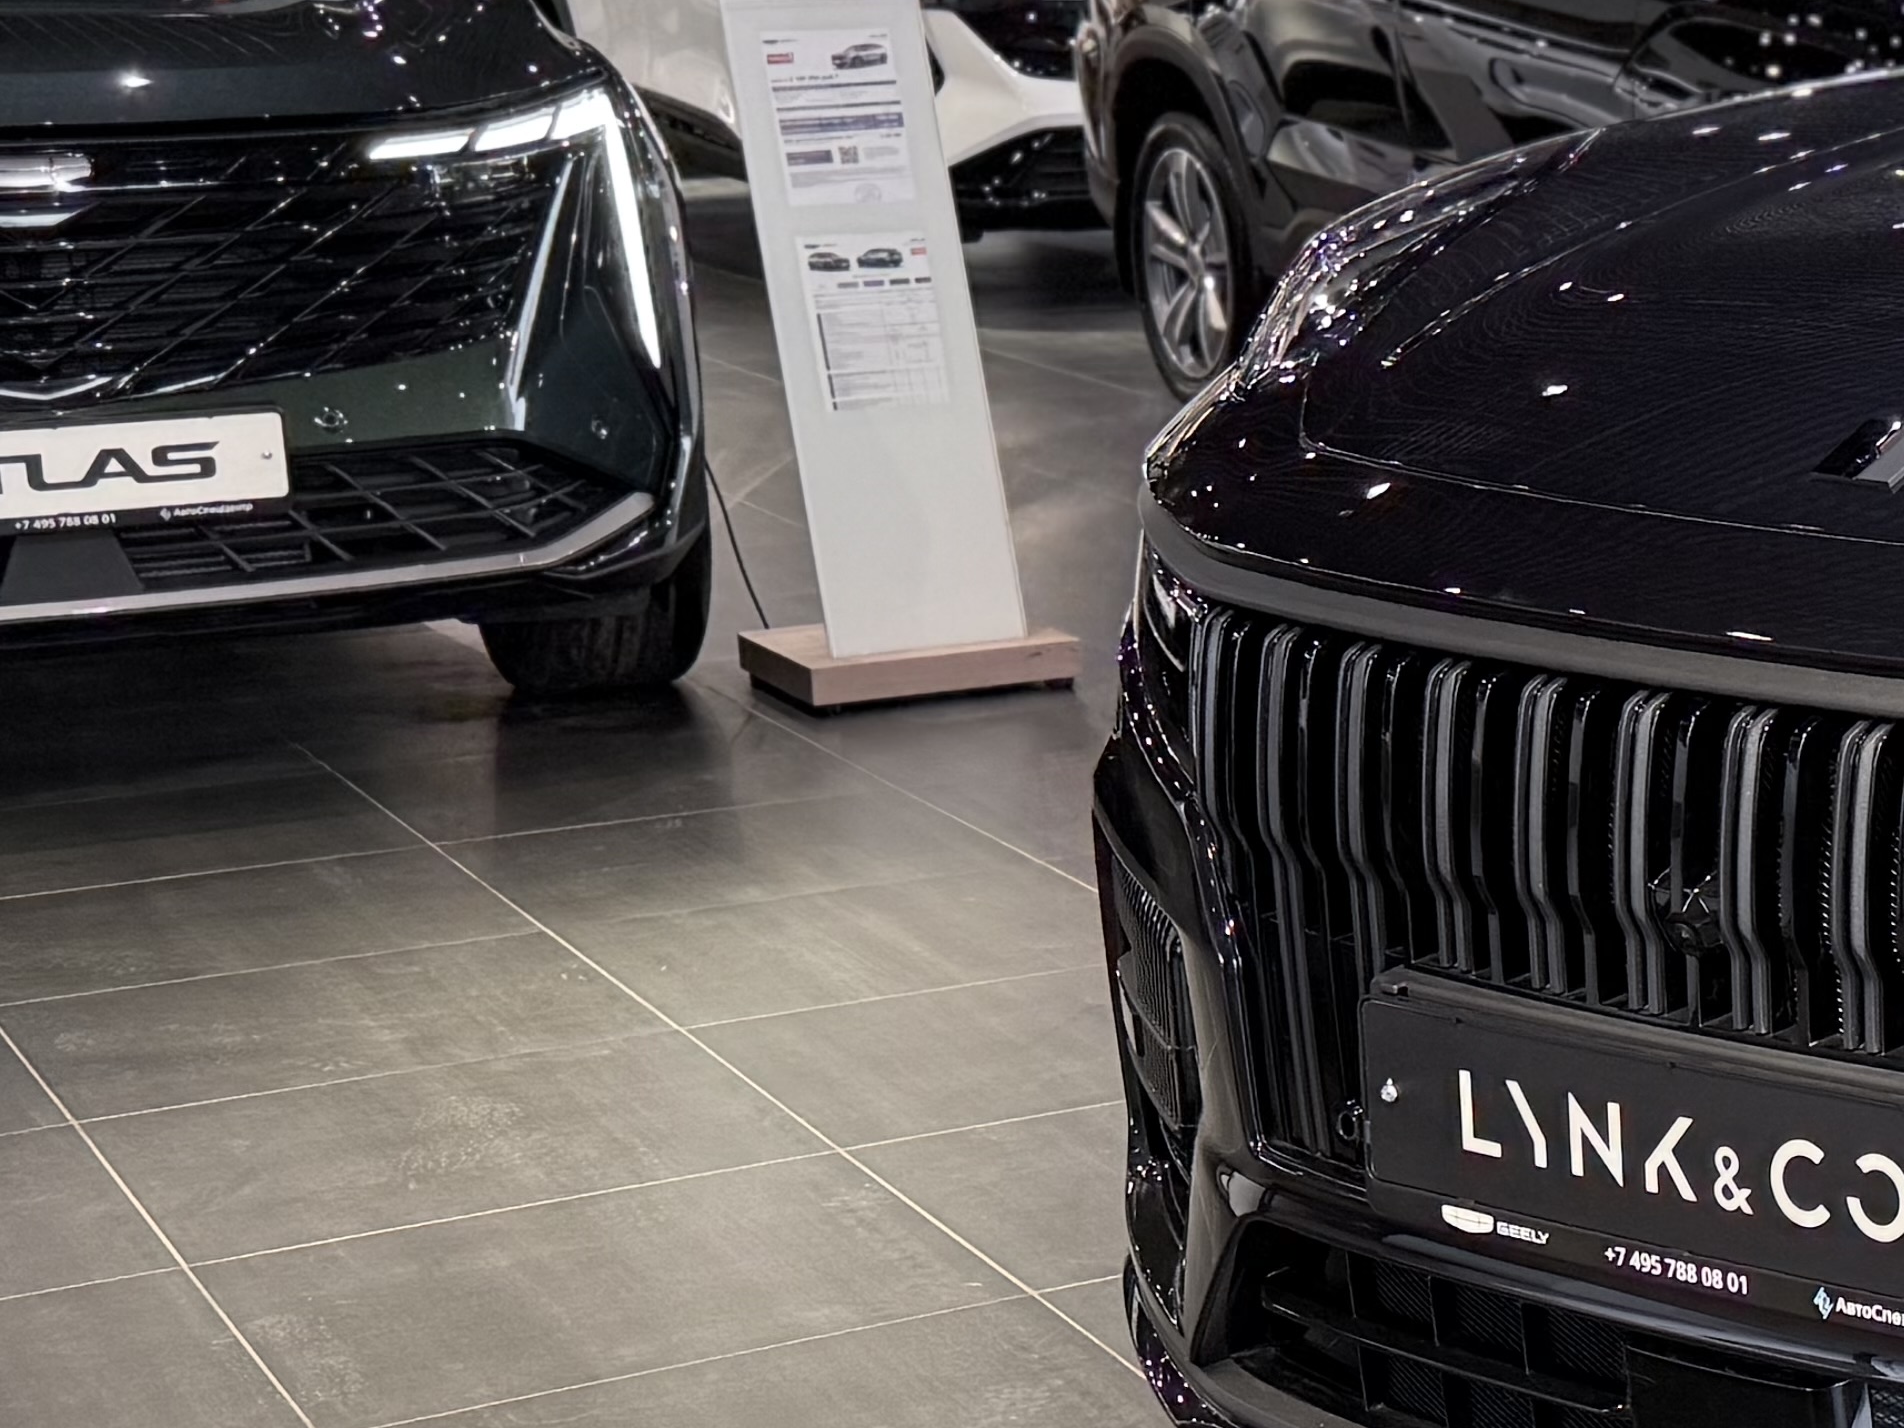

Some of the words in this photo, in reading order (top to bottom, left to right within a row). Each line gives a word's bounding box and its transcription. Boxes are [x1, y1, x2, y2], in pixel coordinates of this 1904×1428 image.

[1496, 1221, 1550, 1245] GEELY
[1604, 1246, 1627, 1267] +7
[1628, 1250, 1662, 1276] 495
[1663, 1257, 1698, 1284] 788
[1700, 1266, 1724, 1290] 08
[1726, 1271, 1748, 1295] 01
